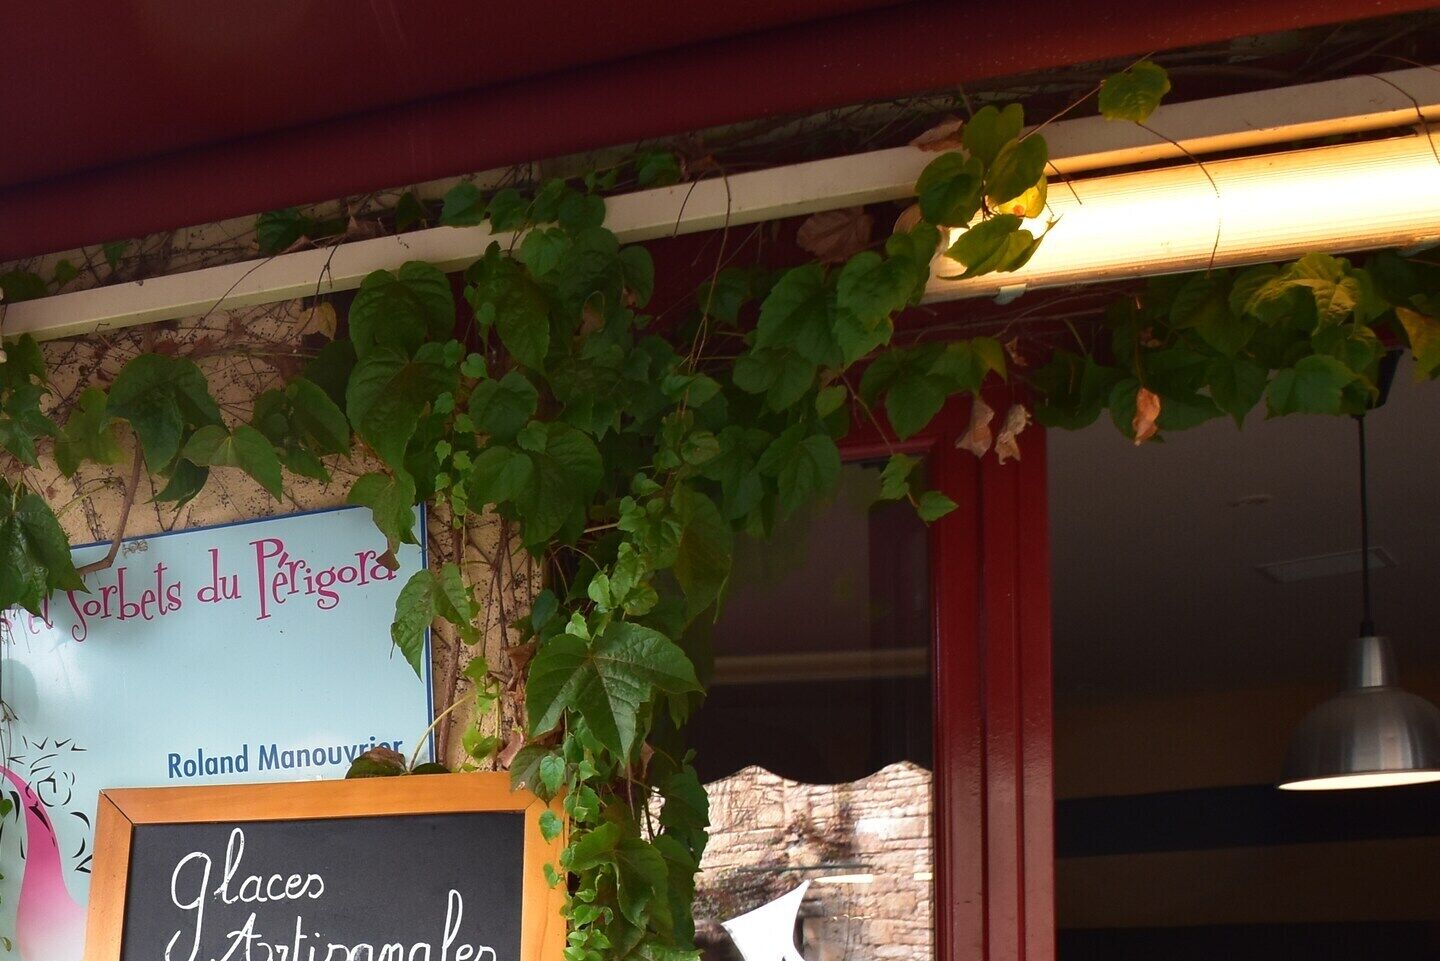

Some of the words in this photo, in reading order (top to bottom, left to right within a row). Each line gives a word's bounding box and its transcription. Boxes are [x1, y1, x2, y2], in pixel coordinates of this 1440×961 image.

[66, 562, 182, 643] Sorbets
[197, 548, 242, 603] du
[168, 747, 248, 778] Roland
